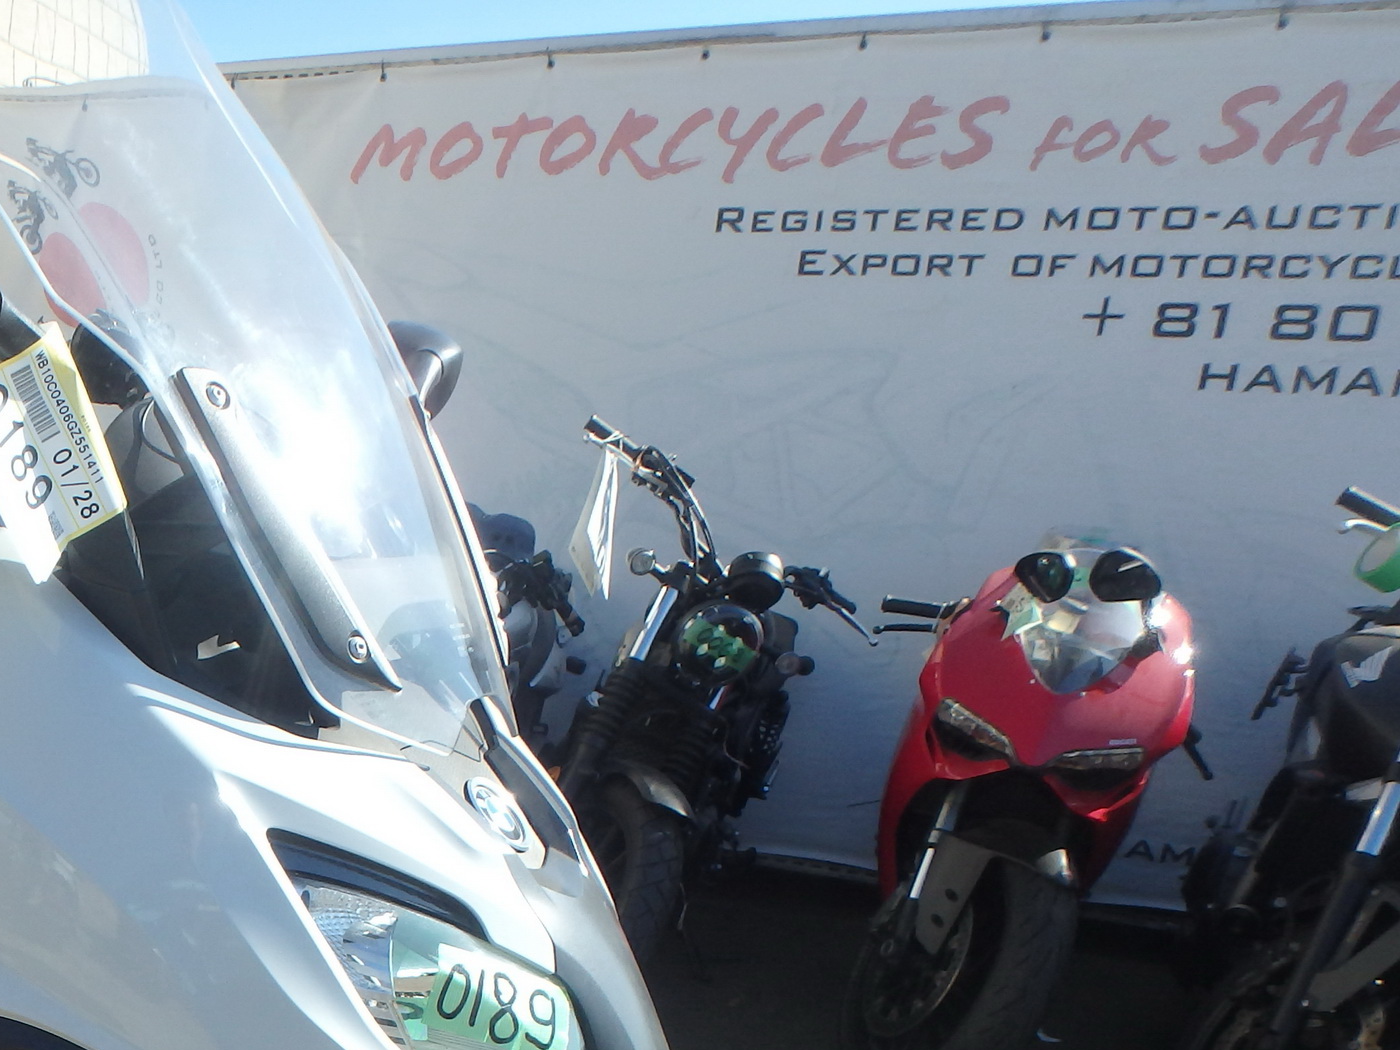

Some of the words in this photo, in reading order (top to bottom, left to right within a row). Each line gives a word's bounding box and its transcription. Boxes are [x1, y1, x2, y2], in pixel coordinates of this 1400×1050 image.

[351, 96, 1011, 184] MOTORCYCLES
[715, 205, 1025, 233] REGISTERED
[798, 250, 986, 277] EXPORT
[1011, 254, 1077, 278] OF
[1152, 302, 1232, 339] 81
[1269, 303, 1381, 343] 80
[53, 448, 100, 519] 01/28
[436, 963, 557, 1050] 0189
